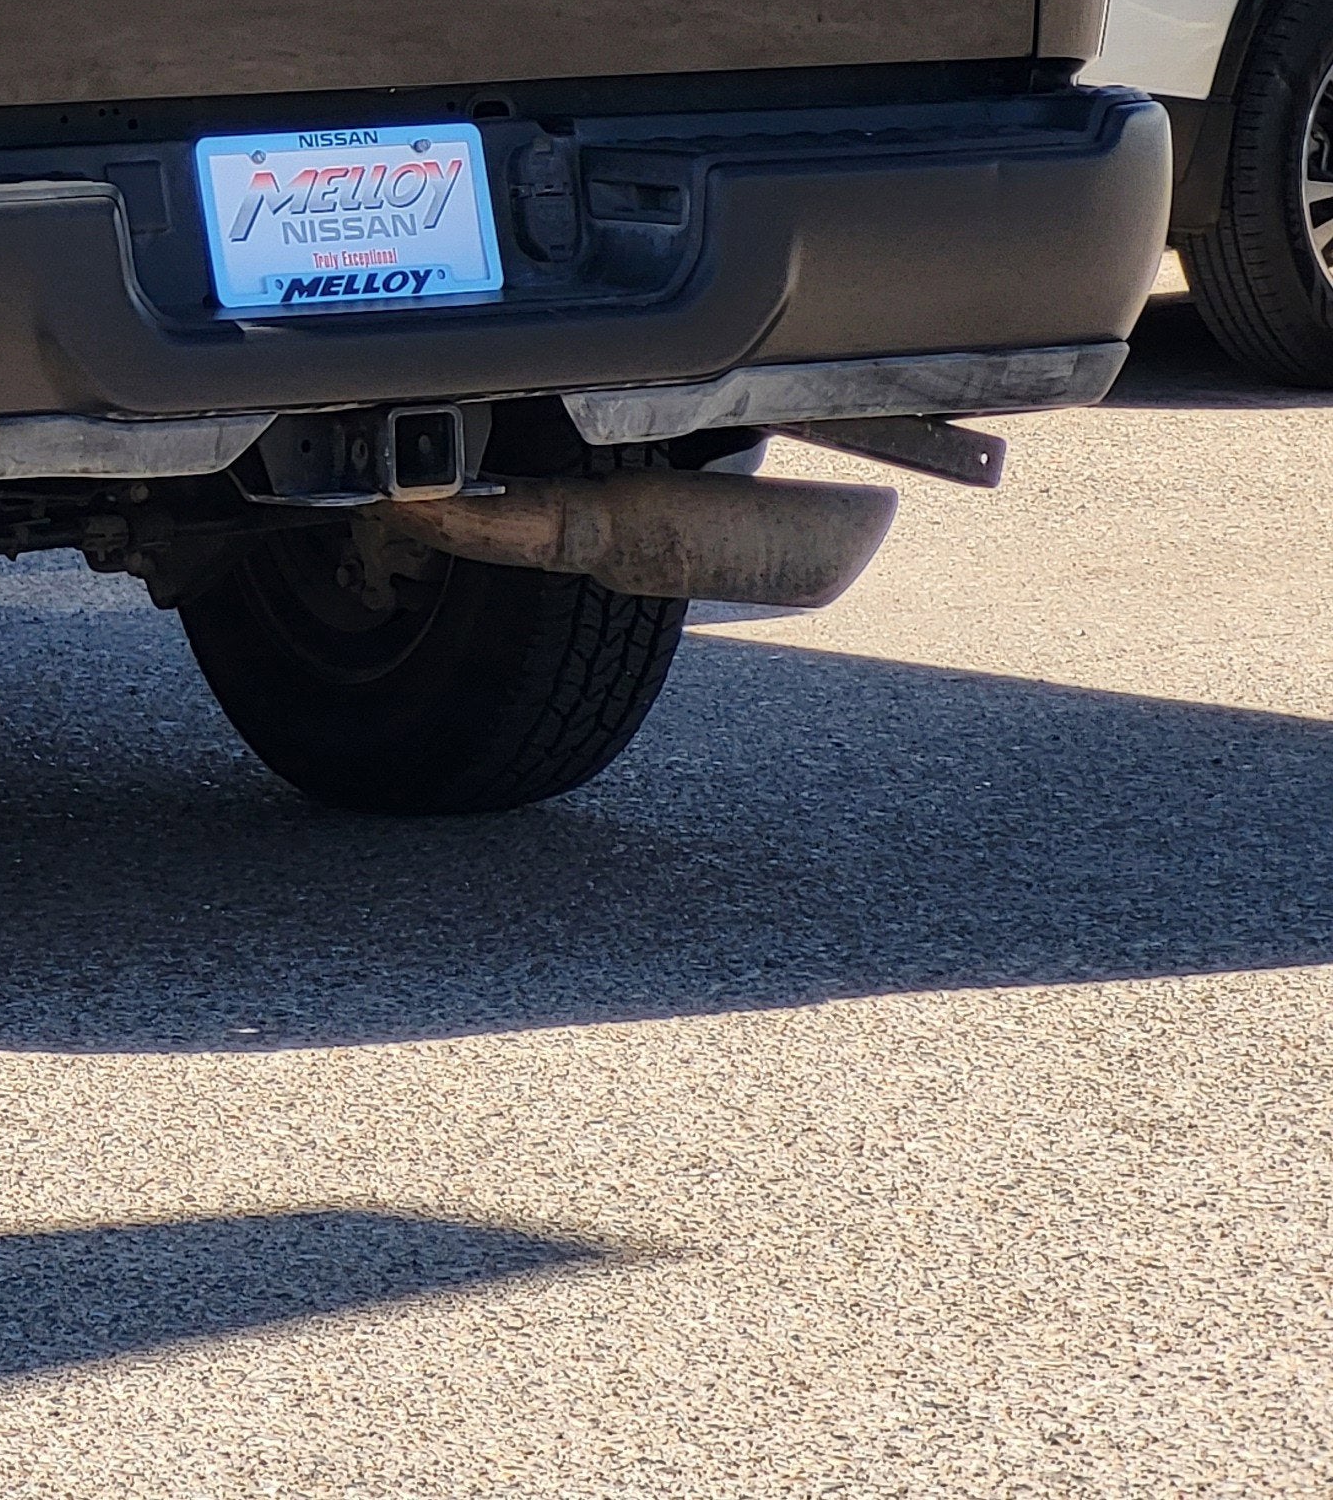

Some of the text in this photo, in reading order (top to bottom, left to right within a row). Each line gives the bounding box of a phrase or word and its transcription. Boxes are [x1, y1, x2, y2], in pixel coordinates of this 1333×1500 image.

[298, 130, 379, 148] NISSAN
[229, 159, 463, 242] MELLOY
[282, 213, 418, 245] NISSAN
[313, 248, 398, 269] Truly Exceptional
[281, 269, 434, 304] MELLOY
